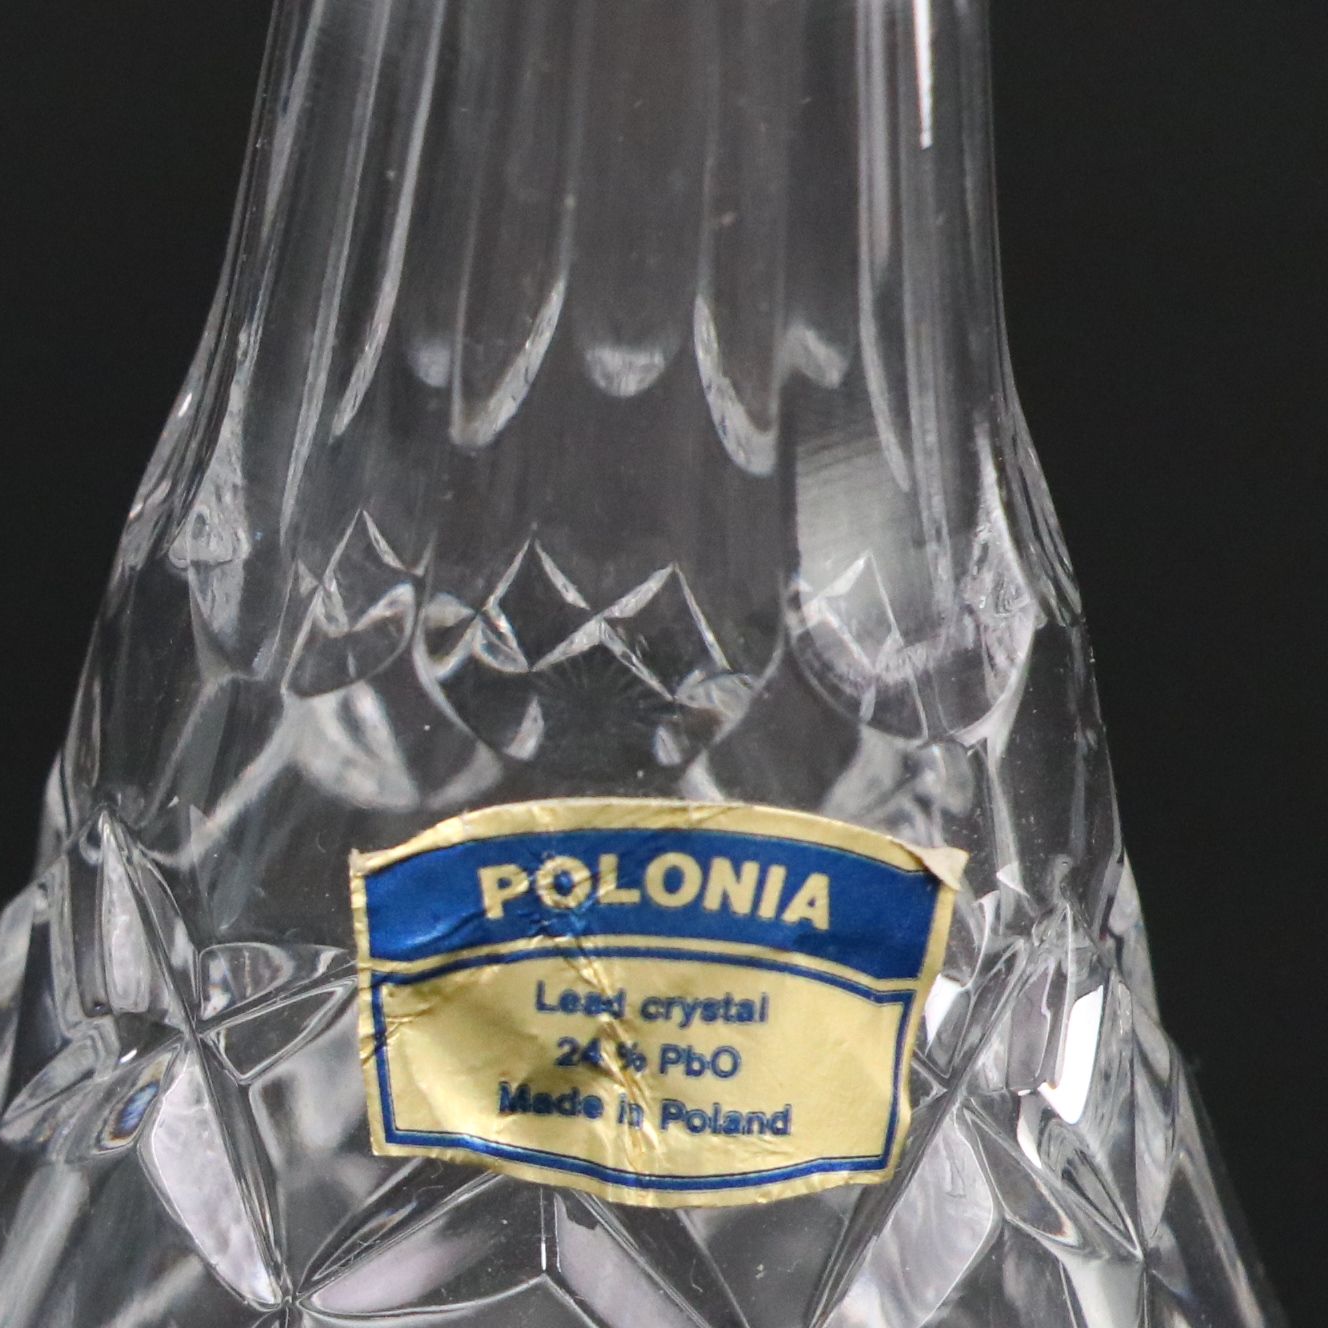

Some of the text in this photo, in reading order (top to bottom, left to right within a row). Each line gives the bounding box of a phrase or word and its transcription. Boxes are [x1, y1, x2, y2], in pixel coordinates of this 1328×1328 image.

[478, 852, 830, 930] POLONIA
[536, 980, 769, 1029] Lead crystal
[660, 1046, 740, 1079] PbO
[499, 1083, 792, 1137] Made in Poland
